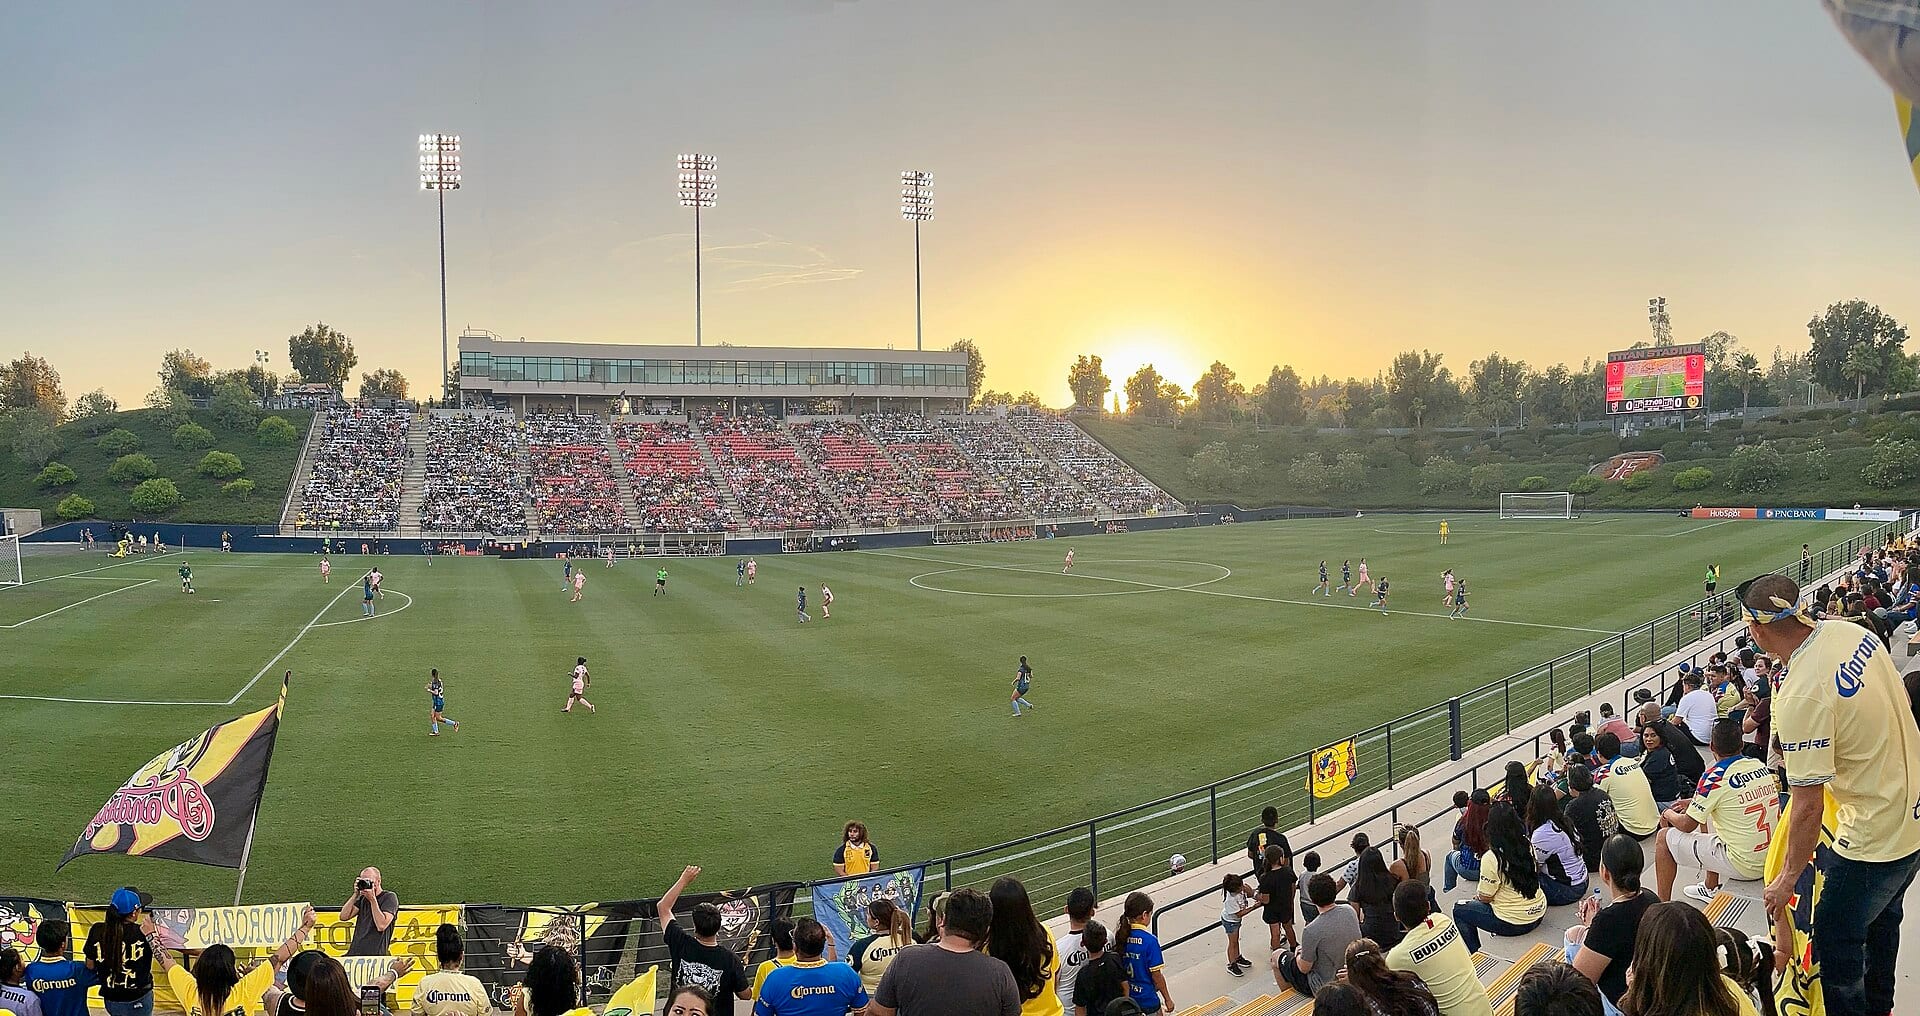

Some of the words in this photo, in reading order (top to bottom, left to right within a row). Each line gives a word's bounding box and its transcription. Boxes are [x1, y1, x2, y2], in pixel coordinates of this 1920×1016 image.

[1609, 350, 1644, 361] TITAN
[1647, 346, 1702, 357] STADIUM
[1710, 509, 1741, 518] HubSpot
[1836, 633, 1880, 698] Coron
[1780, 742, 1797, 752] EE
[1413, 942, 1438, 960] BUD
[32, 977, 77, 993] Corona
[790, 984, 836, 999] Corona
[0, 987, 26, 1004] rona
[427, 989, 471, 1004] Corona
